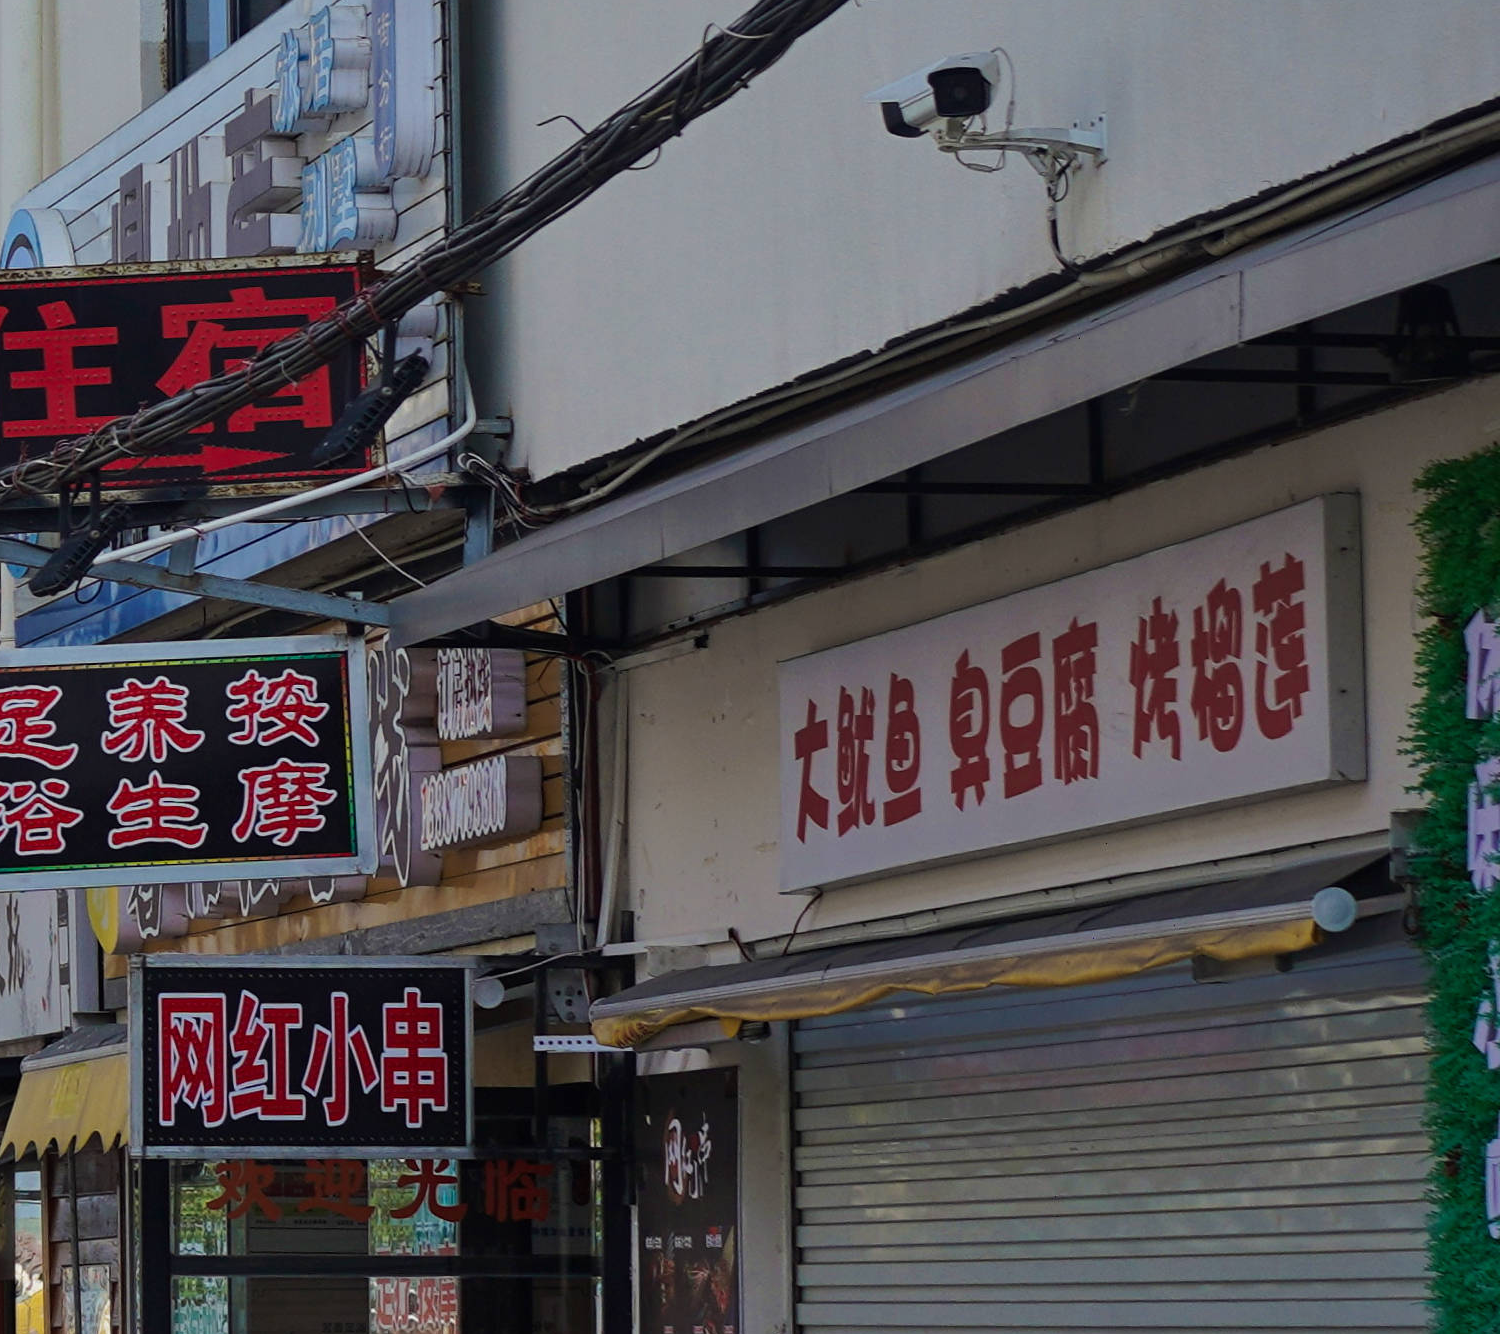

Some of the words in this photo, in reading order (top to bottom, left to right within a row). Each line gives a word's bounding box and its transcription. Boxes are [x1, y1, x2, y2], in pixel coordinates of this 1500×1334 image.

[102, 676, 209, 850] 养生
[225, 668, 340, 848] 按摩
[794, 672, 923, 844] 大鱿鱼
[949, 615, 1100, 812] 臭豆腐
[1128, 551, 1311, 762] 烤榴莲
[157, 986, 449, 1130] 网红小串
